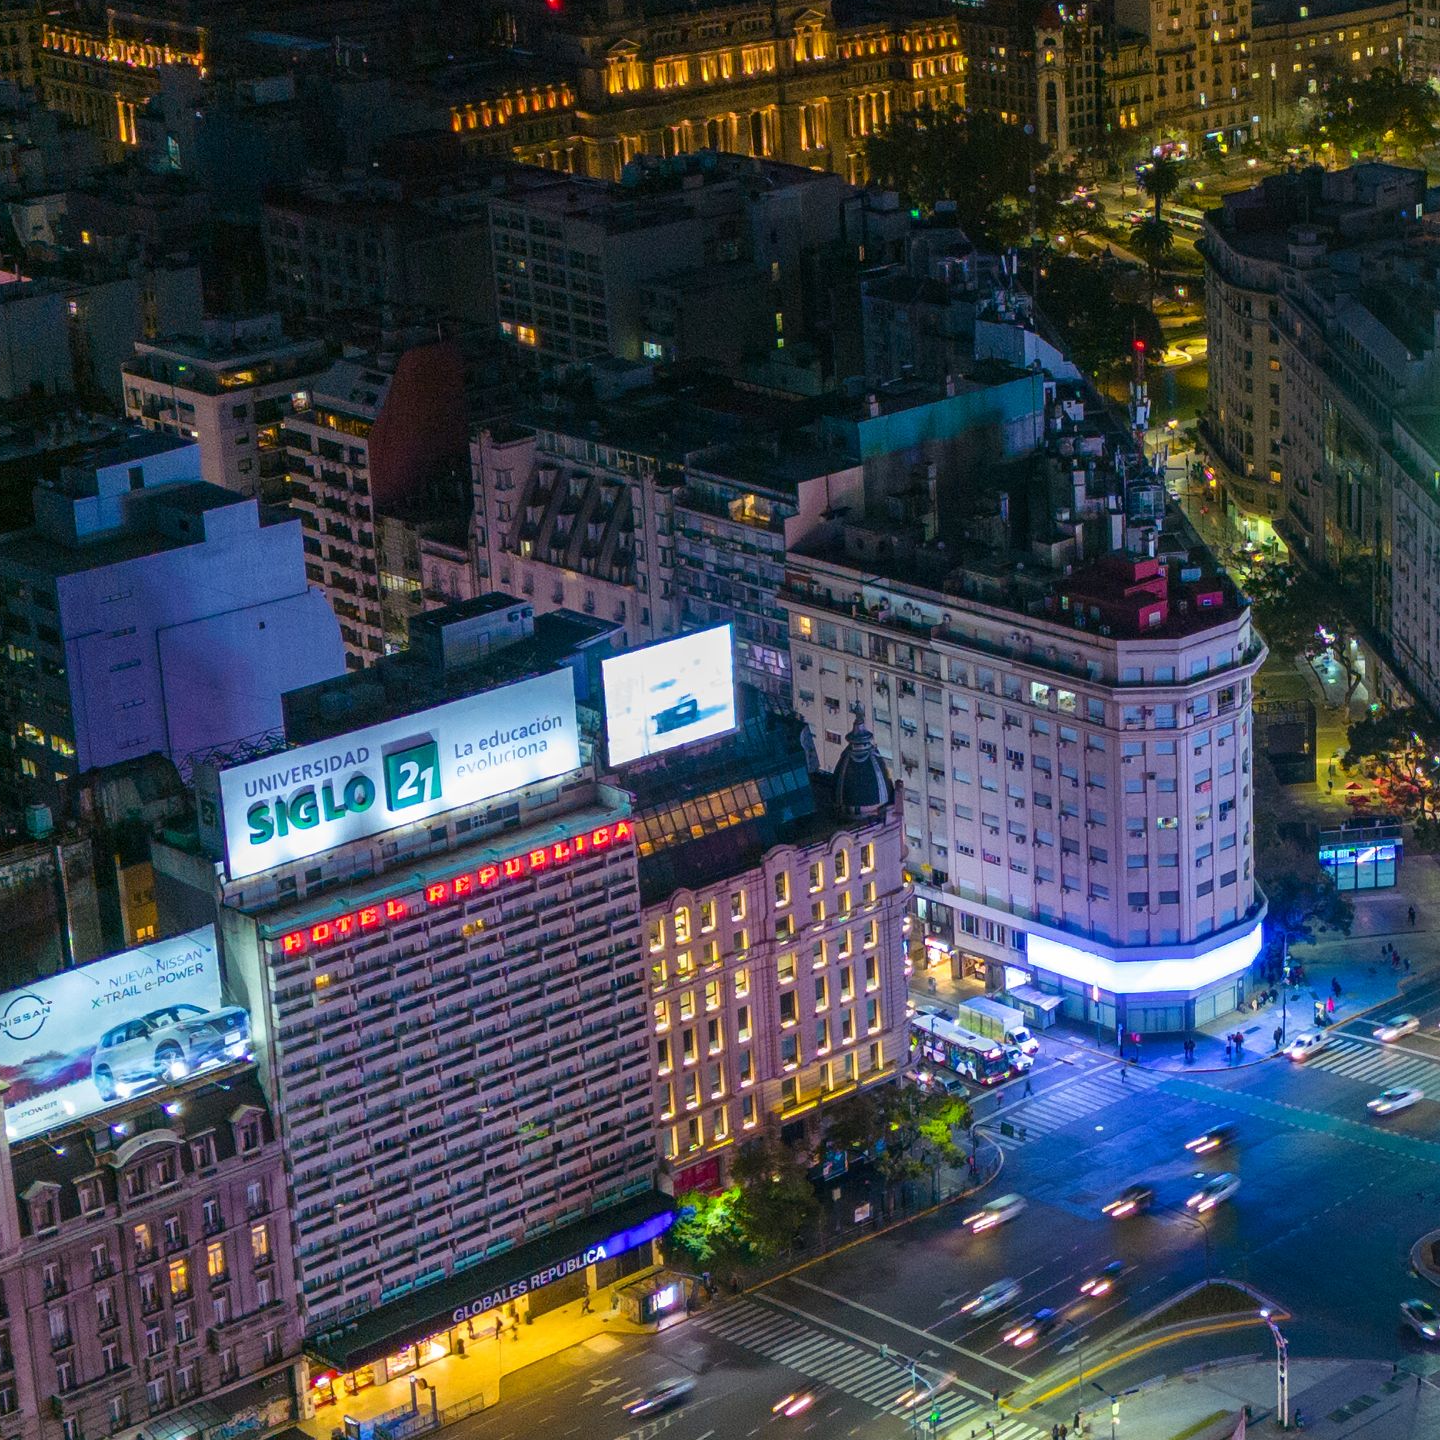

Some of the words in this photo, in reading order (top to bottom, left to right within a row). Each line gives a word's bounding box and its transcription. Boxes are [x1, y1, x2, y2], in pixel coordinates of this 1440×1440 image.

[455, 740, 473, 759] La
[477, 714, 563, 752] educación
[456, 737, 549, 778] evoluciona
[244, 747, 369, 797] UNIVERSIDAD
[247, 775, 376, 844] SIGLO
[396, 761, 435, 805] 21
[283, 898, 405, 952] HOTEL
[427, 822, 630, 903] REPUBLICA
[91, 982, 141, 1009] X-TRAIL
[143, 962, 205, 992] e-POWER
[108, 966, 152, 990] NUEVA
[156, 948, 204, 974] NISSAN
[453, 1281, 527, 1323] GLOBALES
